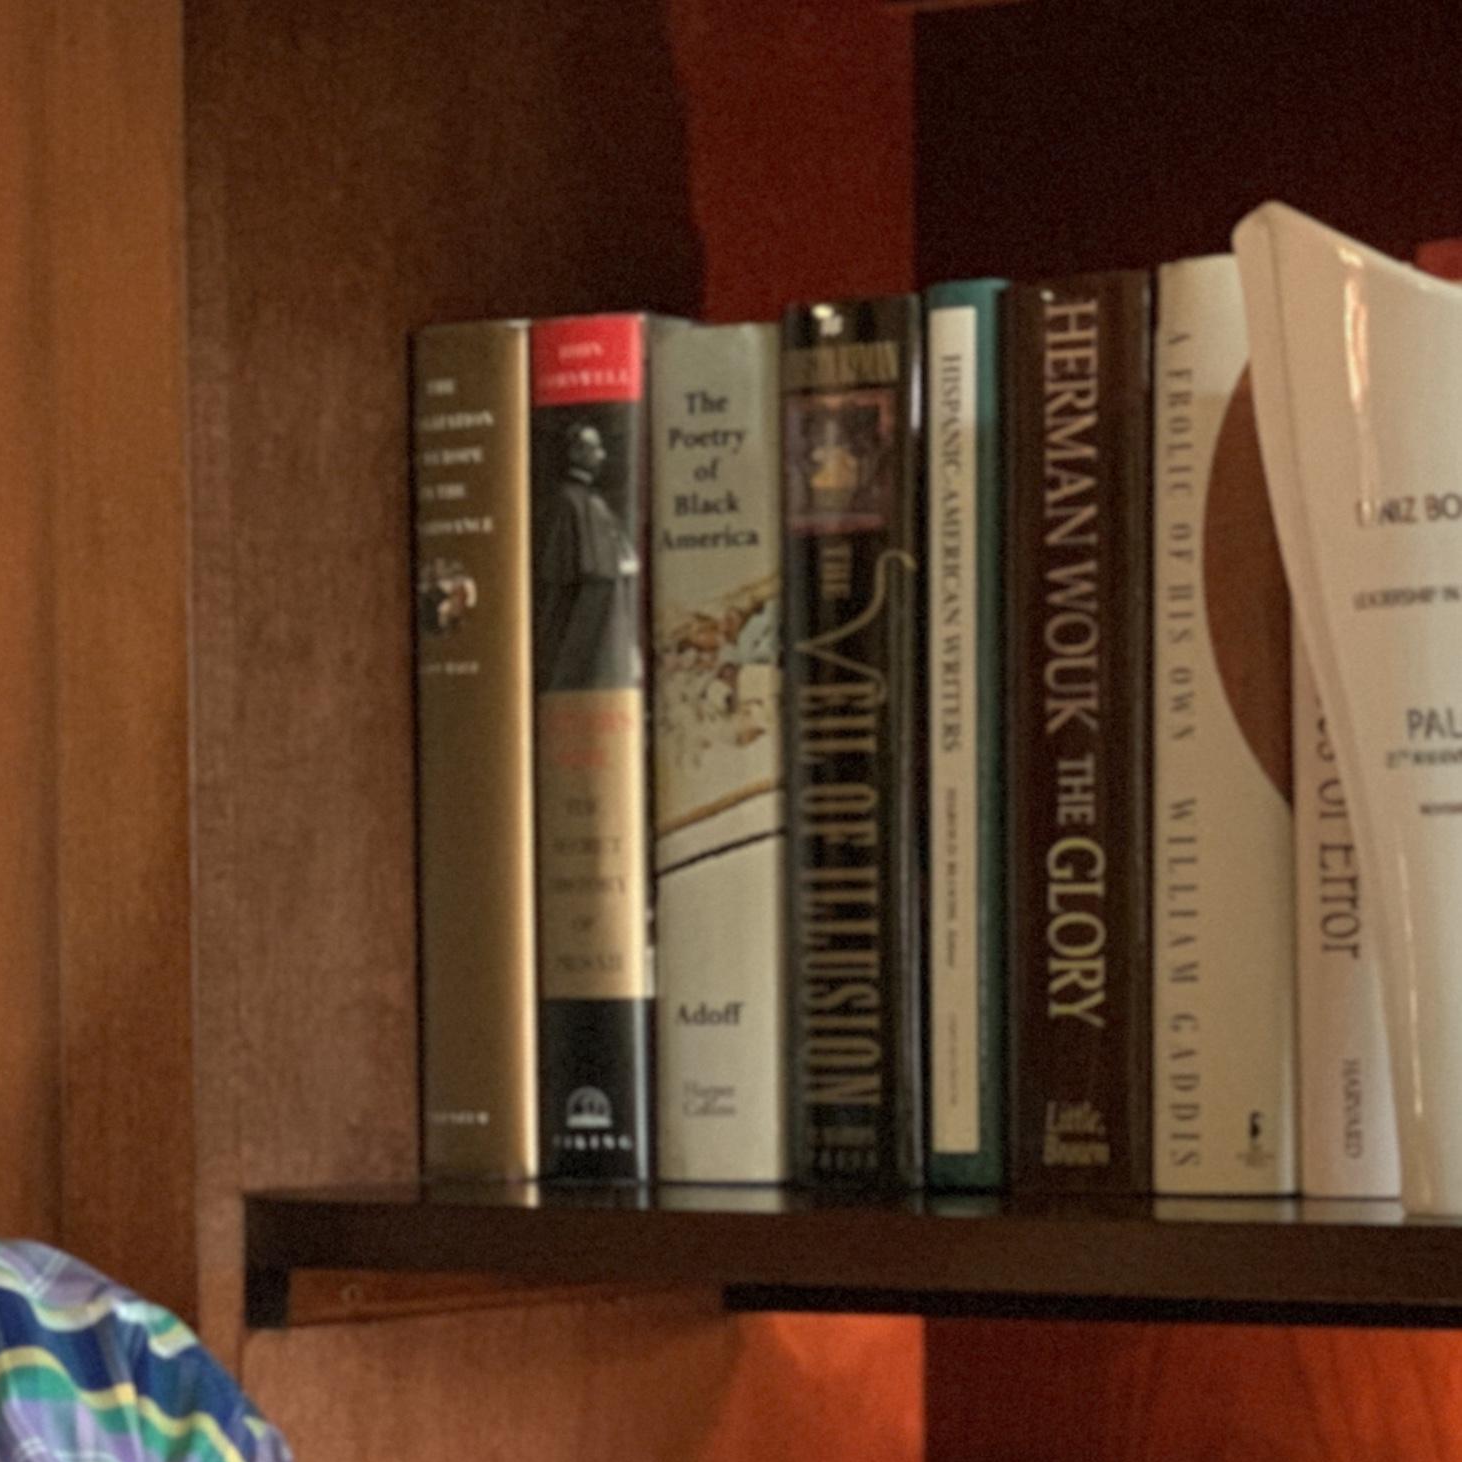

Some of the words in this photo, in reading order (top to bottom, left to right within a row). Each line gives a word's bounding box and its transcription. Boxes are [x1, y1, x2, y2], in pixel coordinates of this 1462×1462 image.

[1166, 329, 1192, 346] A
[685, 392, 728, 417] The
[1045, 300, 1099, 547] HERMAN
[1166, 368, 1194, 496] FROLIC
[668, 427, 745, 453] Poetry
[693, 458, 720, 482] of
[659, 527, 759, 552] America
[674, 494, 740, 517] Black
[1424, 493, 1462, 522] BO
[1169, 522, 1195, 563] OF
[1045, 563, 1099, 734] WOUK
[1168, 584, 1195, 644] HIS
[939, 634, 963, 753] WRITERS
[1168, 666, 1196, 742] OWN
[1405, 707, 1462, 740] PAL
[799, 783, 881, 847] OF
[1057, 753, 1096, 827] THE
[1168, 797, 1199, 985] WILLIAM
[1320, 842, 1362, 960] Error
[1046, 837, 1108, 1030] GLORY
[675, 1002, 745, 1027] Adoff
[799, 866, 882, 1107] ILLUSION
[1169, 1012, 1200, 1168] GADDIS
[1342, 1058, 1363, 1160] HARVARD
